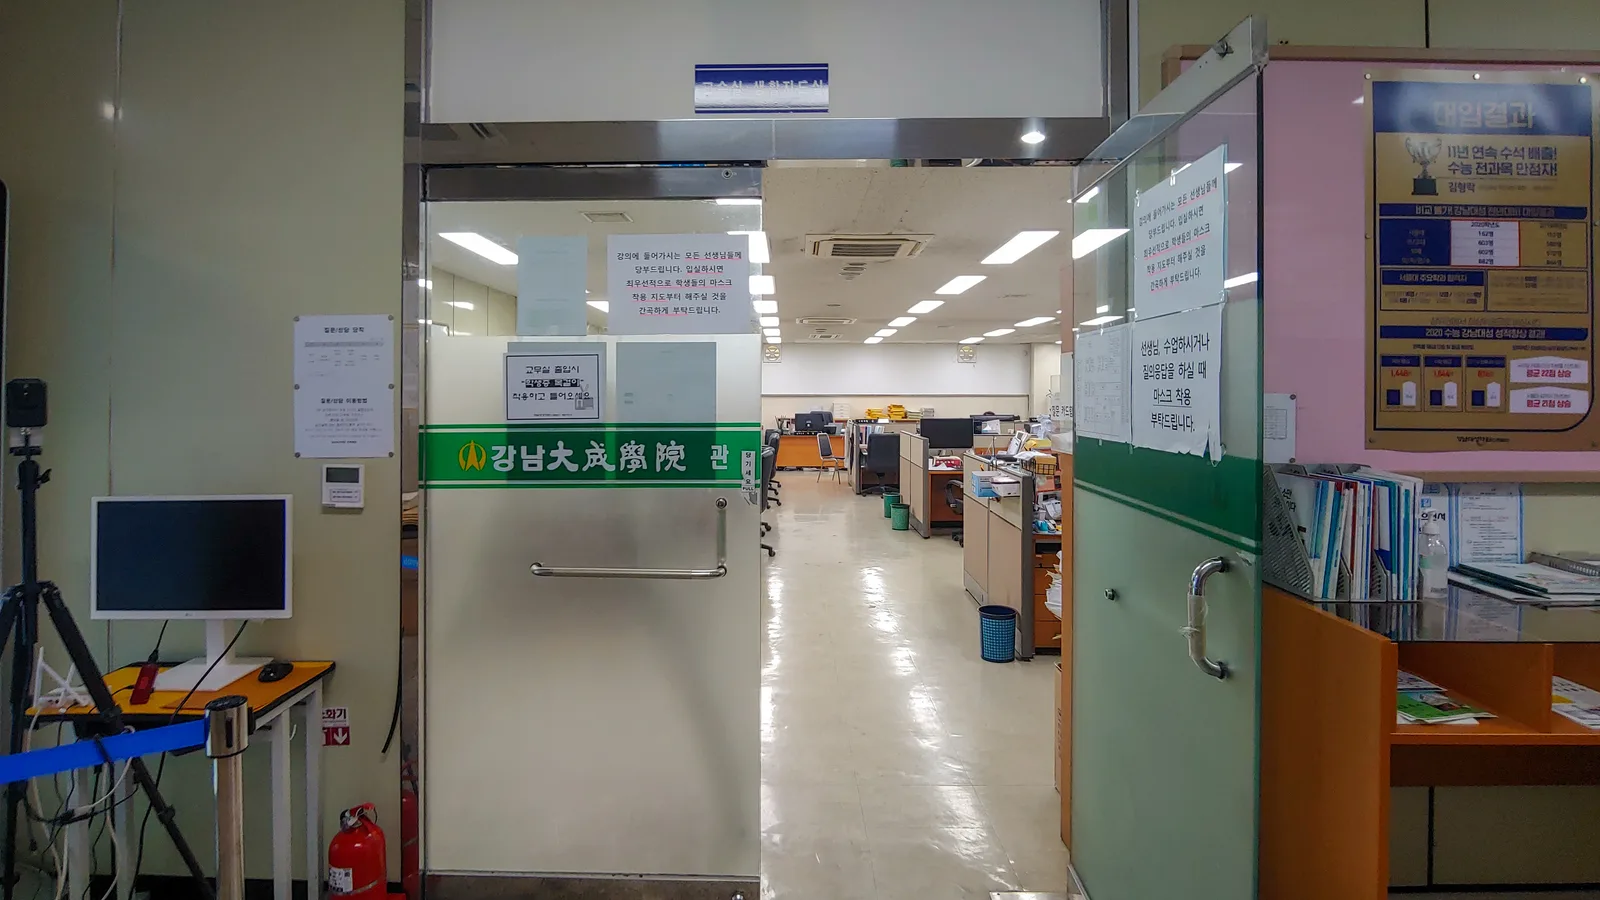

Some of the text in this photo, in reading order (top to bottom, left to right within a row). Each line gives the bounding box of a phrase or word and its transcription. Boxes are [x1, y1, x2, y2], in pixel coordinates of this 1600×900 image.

[1433, 101, 1536, 129] 대입결과
[1447, 145, 1469, 159] 11년
[1472, 146, 1497, 160] 연속
[1500, 146, 1525, 160] 수석
[1447, 162, 1557, 176] 수능 전과목 만점자!
[1177, 193, 1187, 206] 모든
[1148, 205, 1204, 239] 당부드립니다. 입실하시면
[1171, 233, 1192, 247] 학생들의
[1193, 223, 1211, 238] 마스크
[616, 251, 742, 261] 강의에 들어가시는 모든 선생님들께
[1157, 258, 1176, 272] 지도부터
[1195, 244, 1206, 258] 것을
[635, 265, 724, 274] 당부드립니다. 입실하시면
[1170, 267, 1202, 285] 부탁드립니다.
[626, 278, 732, 287] 최우선적으로 학생들의 마스크
[632, 292, 727, 301] 착용 지도부터 해주실 것을
[639, 306, 721, 315] 간곡하게 부탁드립니다.
[1426, 328, 1443, 337] 2020
[1140, 333, 1210, 357] 선생님, 수업하시거나
[525, 365, 580, 374] 교무실 출입시
[1143, 361, 1207, 381] 질의응답을 하실 때
[1153, 388, 1192, 406] 마스크 착용
[1151, 413, 1196, 432] 부탁드립니다.
[491, 440, 729, 473] 강남大成學院 관
